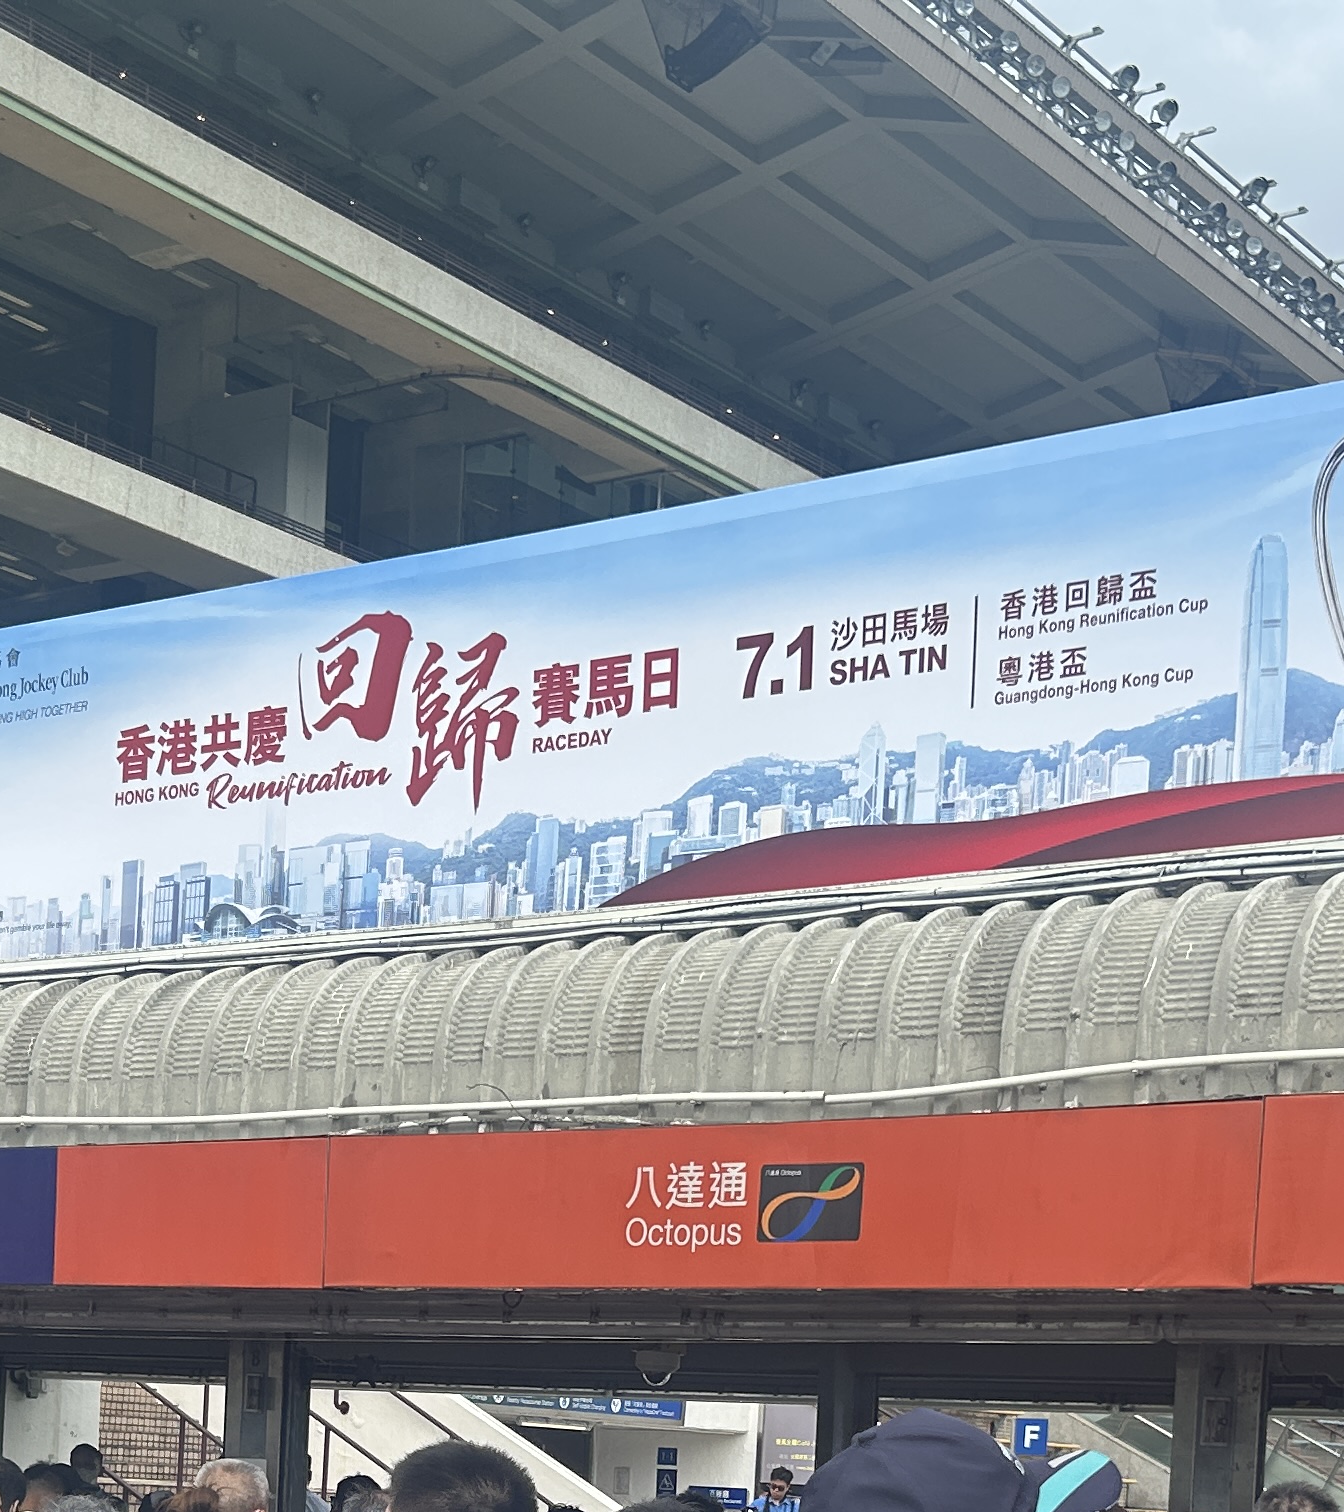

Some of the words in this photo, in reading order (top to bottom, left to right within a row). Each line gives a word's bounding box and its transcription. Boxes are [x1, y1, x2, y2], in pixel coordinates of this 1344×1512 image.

[1000, 568, 1157, 621] 香港回歸盃
[830, 602, 949, 651] 沙田馬場
[998, 620, 1033, 640] Hong
[1039, 616, 1075, 634] Kong
[1079, 602, 1174, 629] Reunification
[1179, 596, 1209, 616] Cup
[16, 674, 58, 700] Jockey
[61, 666, 89, 688] Club
[736, 625, 815, 699] 7.1
[830, 654, 890, 686] SHA
[899, 644, 948, 678] TIN
[996, 646, 1087, 687] 粵港盃
[994, 674, 1118, 706] Guangdong-Hong
[1122, 670, 1159, 689] Kong
[1164, 665, 1194, 686] Cup
[15, 709, 39, 721] HIGH
[40, 700, 89, 718] TOGETHER
[115, 706, 288, 782] 香港共慶
[299, 609, 521, 815] 回歸
[533, 647, 680, 728] 賽馬日
[115, 785, 156, 806] HONG
[158, 781, 199, 802] KONG
[207, 760, 392, 810] Reunification
[532, 727, 612, 754] RACEDAY
[32, 923, 46, 932] your
[625, 1161, 748, 1210] 八達通
[625, 1217, 742, 1253] Octopus
[1024, 1425, 1040, 1448] F
